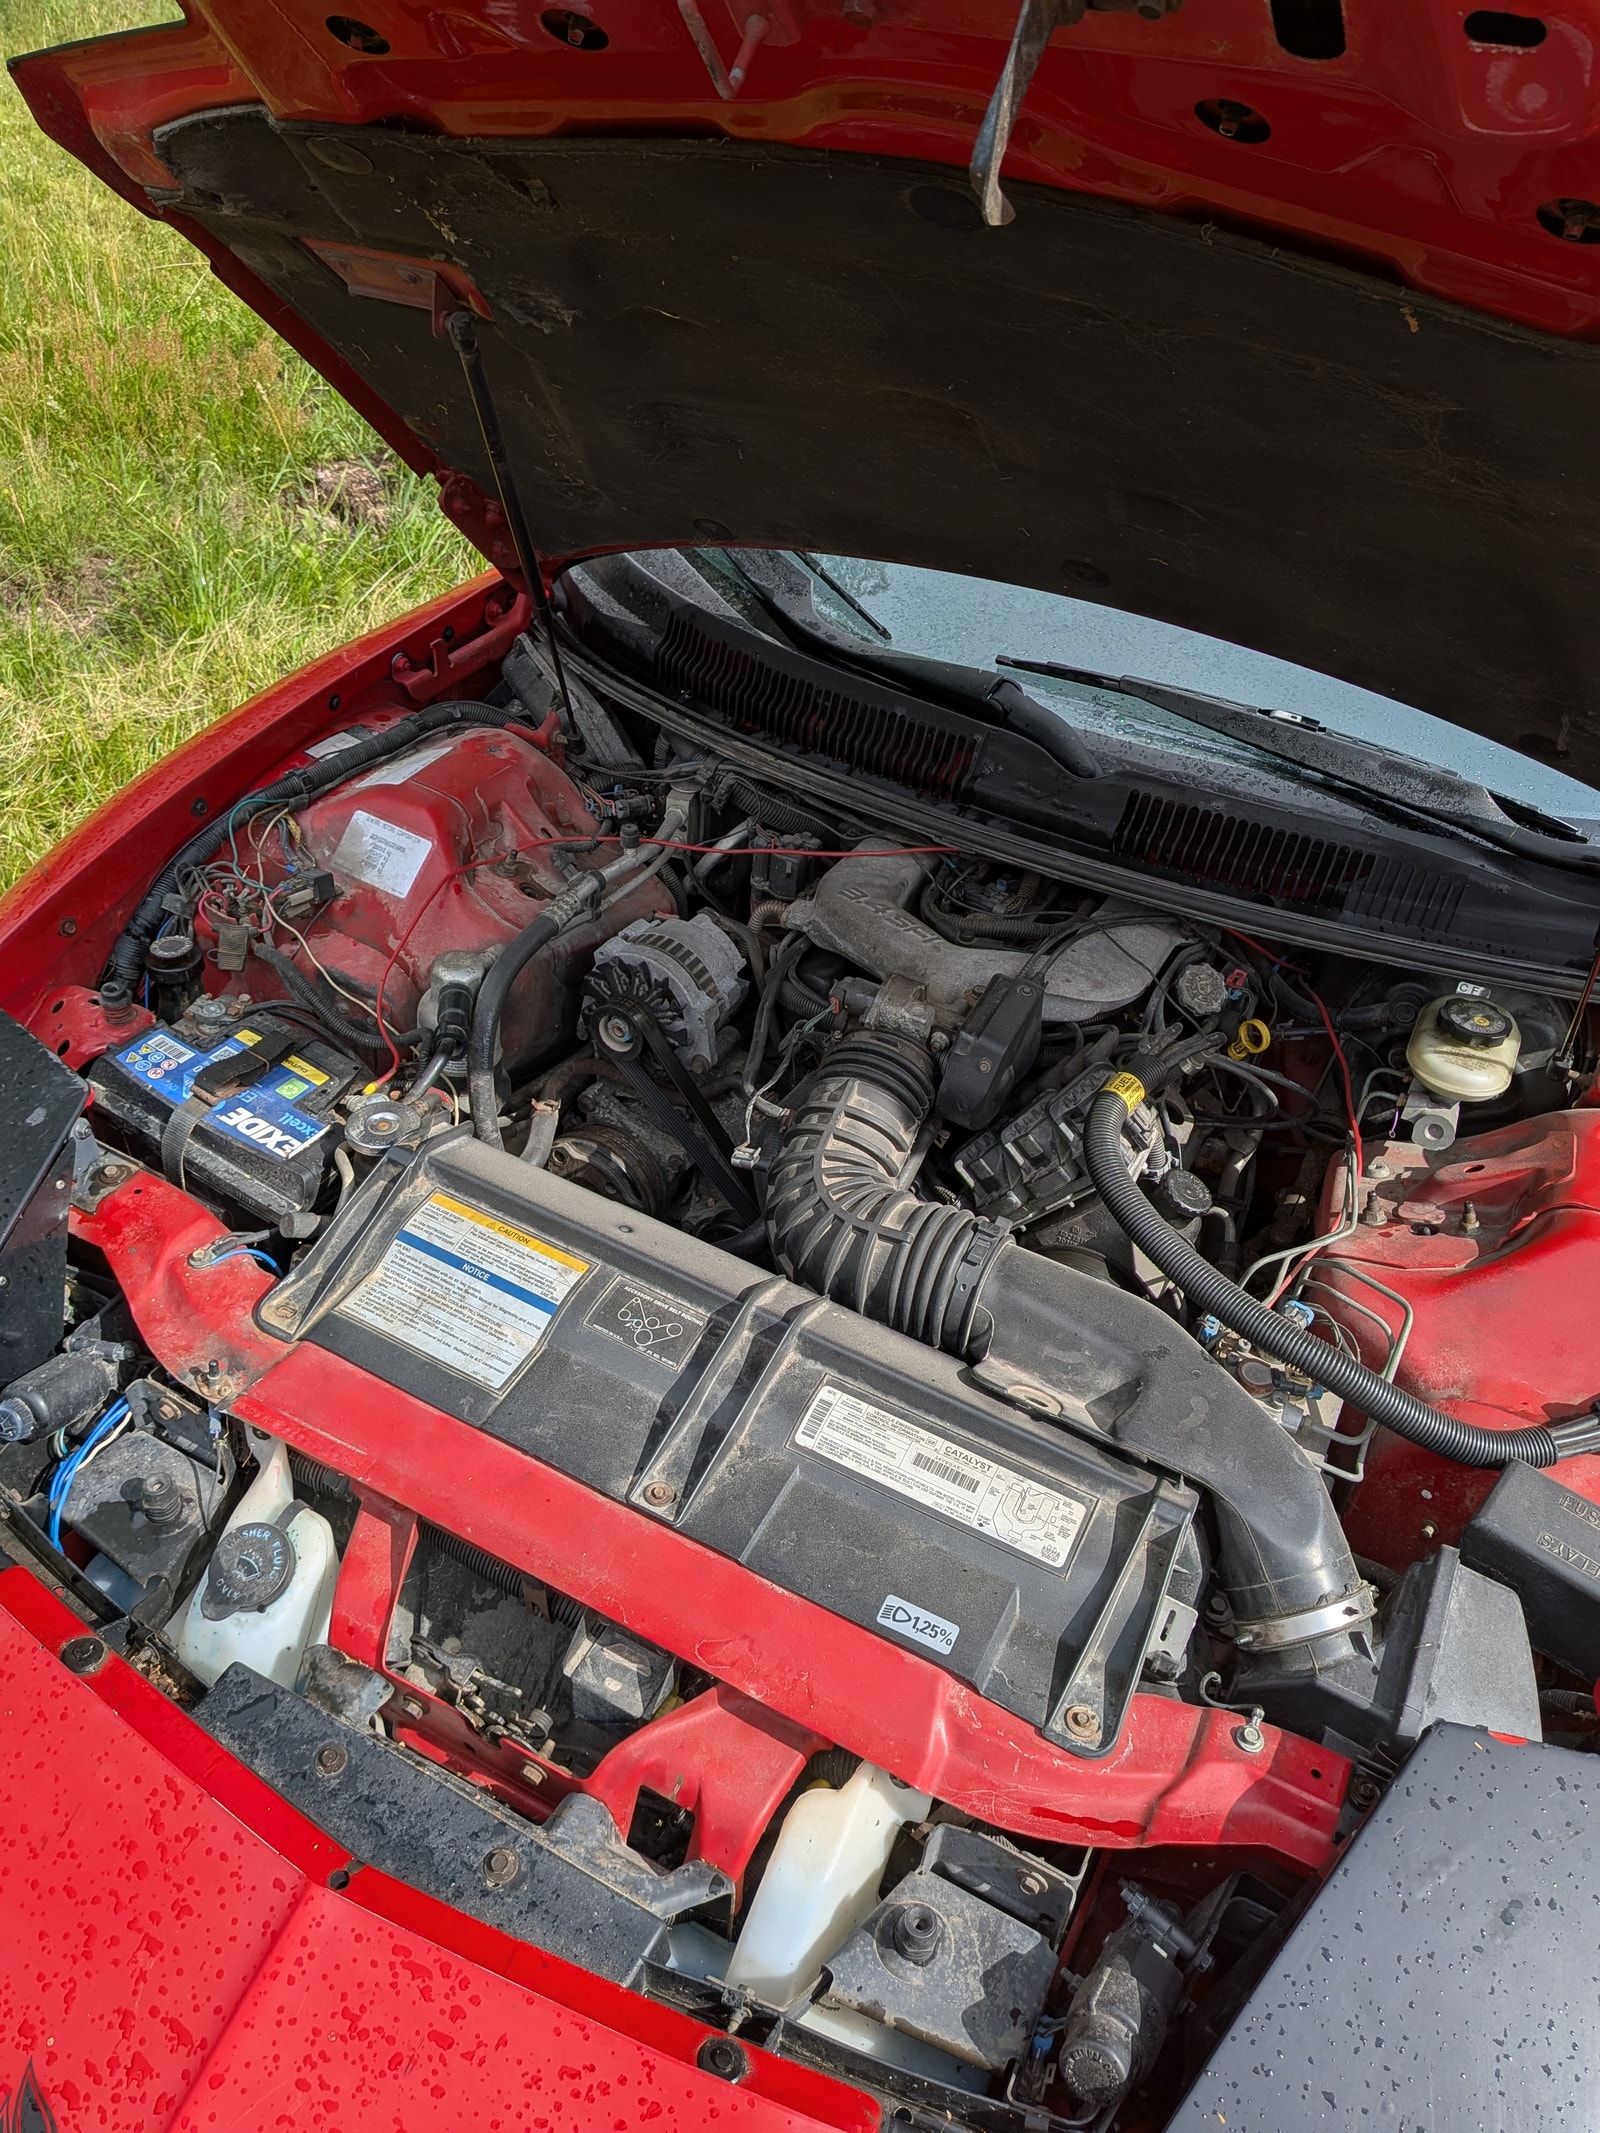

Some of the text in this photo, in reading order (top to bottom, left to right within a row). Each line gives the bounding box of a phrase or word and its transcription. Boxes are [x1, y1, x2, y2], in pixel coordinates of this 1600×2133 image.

[1114, 1076, 1132, 1092] FUEL
[219, 1107, 303, 1159] EXIDE
[496, 1225, 531, 1244] CAUTION
[460, 1262, 491, 1281] NOTICE
[624, 1286, 704, 1326] ACCESSORY DRIVE BELT ROUTING
[865, 1411, 890, 1425] CONTROL
[890, 1422, 926, 1442] INFORMATION
[873, 1410, 895, 1422] VEHICLE
[895, 1420, 920, 1434] EMISSION
[943, 1445, 993, 1473] CATALYST
[1561, 1494, 1600, 1529] FUS
[1538, 1533, 1600, 1579] ELAYS
[910, 1616, 954, 1647] 1,25%
